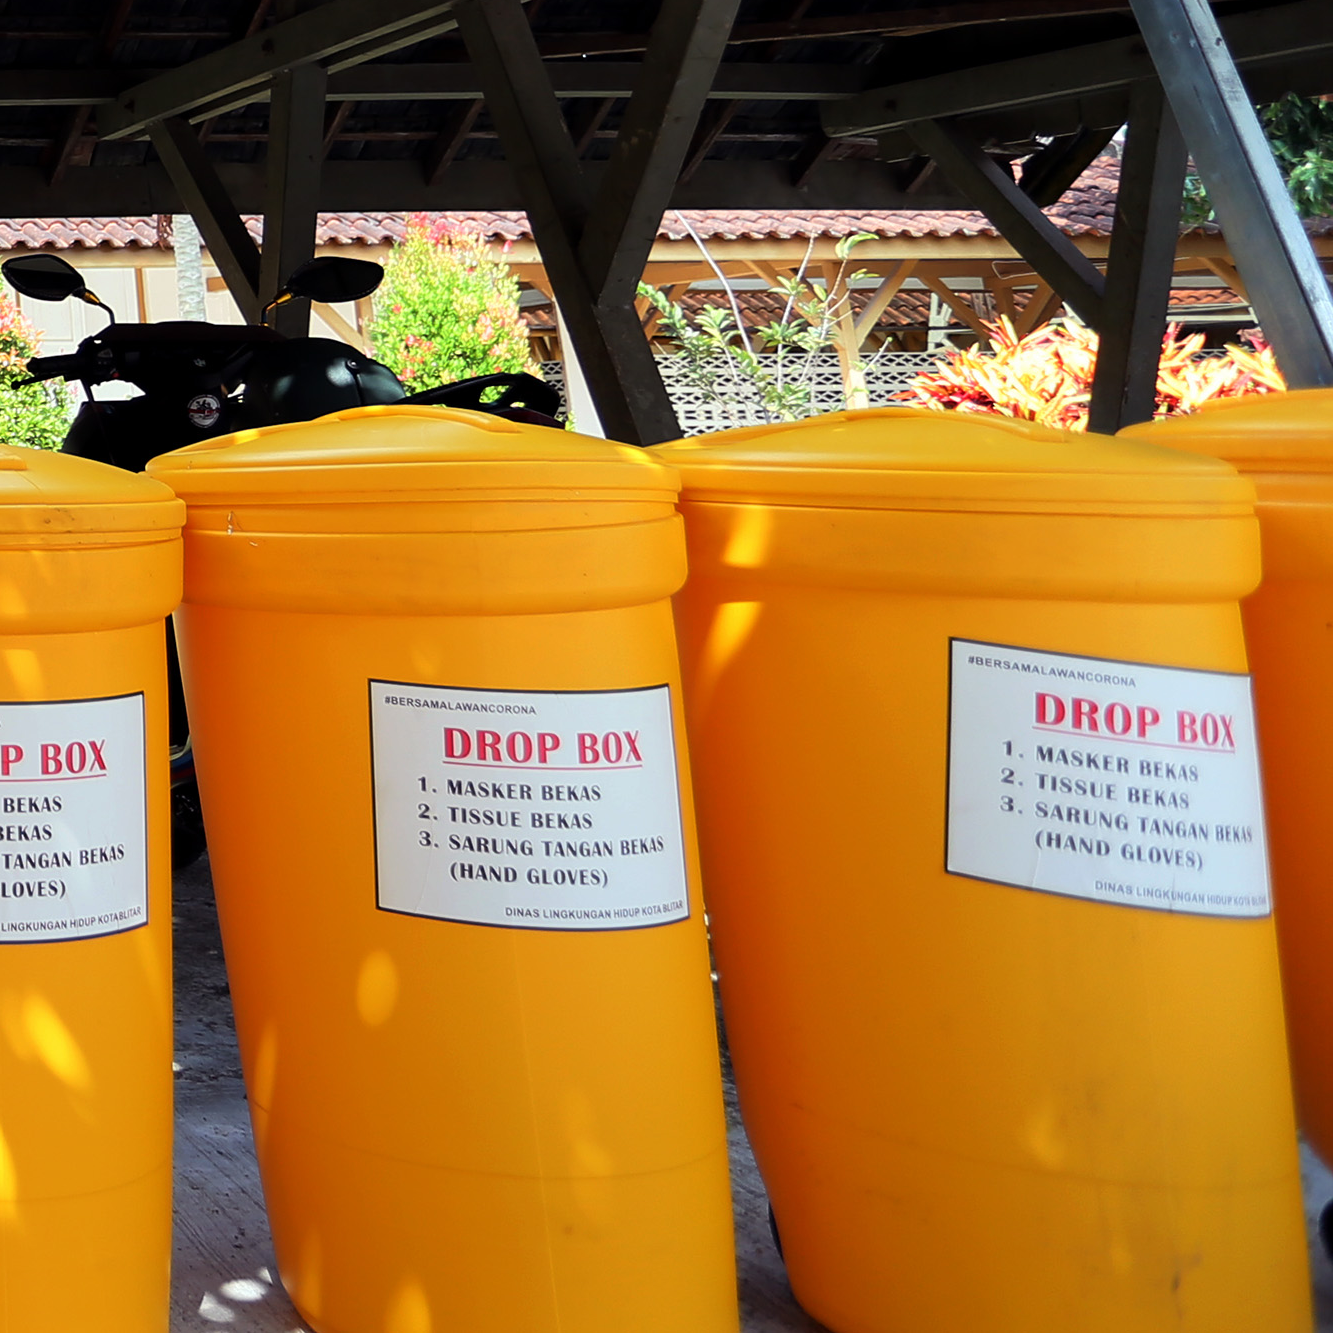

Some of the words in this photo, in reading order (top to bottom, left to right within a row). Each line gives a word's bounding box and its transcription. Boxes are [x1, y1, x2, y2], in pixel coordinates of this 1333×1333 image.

[968, 656, 1137, 687] #BERSAMALAWANCORONA
[384, 696, 536, 715] #BERSAMALAWANCORONA
[1034, 692, 1161, 739] DROP
[1176, 710, 1235, 748] BOX
[41, 739, 107, 775] BOX
[443, 727, 560, 764] DROP
[577, 730, 642, 764] BOX
[1002, 740, 1024, 758] 1.
[1036, 745, 1130, 774] MASKER
[1139, 759, 1199, 782] BEKAS
[418, 776, 437, 793] 1.
[447, 779, 532, 801] MASKER
[541, 785, 602, 801] BEKAS
[1001, 768, 1023, 786] 2.
[1035, 772, 1118, 800] TISSUE
[1127, 786, 1189, 809] BEKAS
[3, 796, 63, 813] BEKAS
[418, 804, 438, 820] 2.
[447, 807, 521, 827] TISSUE
[531, 812, 593, 829] BEKAS
[1000, 796, 1023, 814] 3.
[1035, 802, 1129, 831] SARUNG
[1137, 817, 1209, 841] TANGAN
[1215, 826, 1252, 844] BEKAS
[2, 851, 72, 869] TANGAN
[79, 844, 125, 866] BEKAS
[419, 831, 439, 848] 3.
[448, 834, 533, 856] SARUNG
[541, 840, 613, 857] TANGAN
[620, 836, 664, 856] BEKAS
[1035, 829, 1111, 856] (HAND
[1121, 843, 1204, 870] GLOVES)
[450, 862, 517, 883] (HAND
[526, 868, 609, 888] GLOVES)
[505, 907, 540, 918] DINAS
[542, 909, 611, 919] LINGKUNGAN
[613, 908, 640, 918] HIDUP
[642, 905, 661, 916] KOTA
[663, 900, 684, 913] BLITAR
[1, 920, 67, 932] LINGKUNGAN
[70, 917, 96, 928] HIDUP
